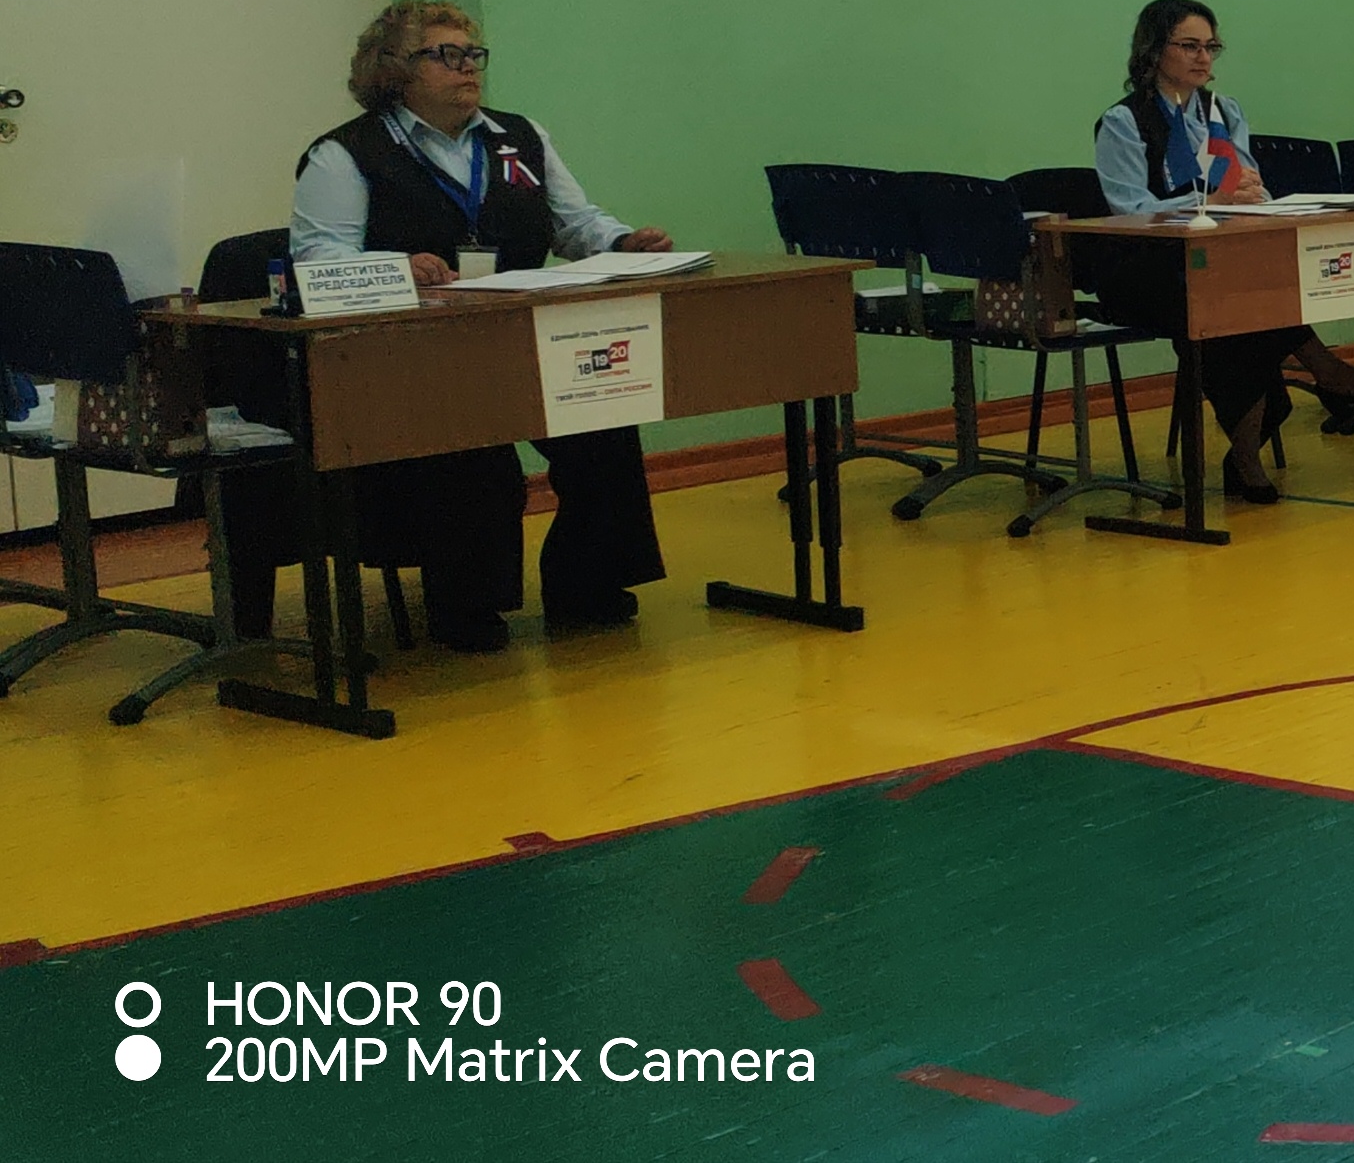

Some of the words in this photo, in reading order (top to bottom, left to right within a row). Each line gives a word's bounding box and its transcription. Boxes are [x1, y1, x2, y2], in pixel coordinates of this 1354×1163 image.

[308, 263, 400, 279] ЗАМЕСТИТЕЛЬ
[307, 274, 407, 291] ПРЕДСЕДАТЕЛЯ
[577, 363, 592, 376] 18
[593, 353, 608, 368] 19
[610, 344, 627, 359] 20
